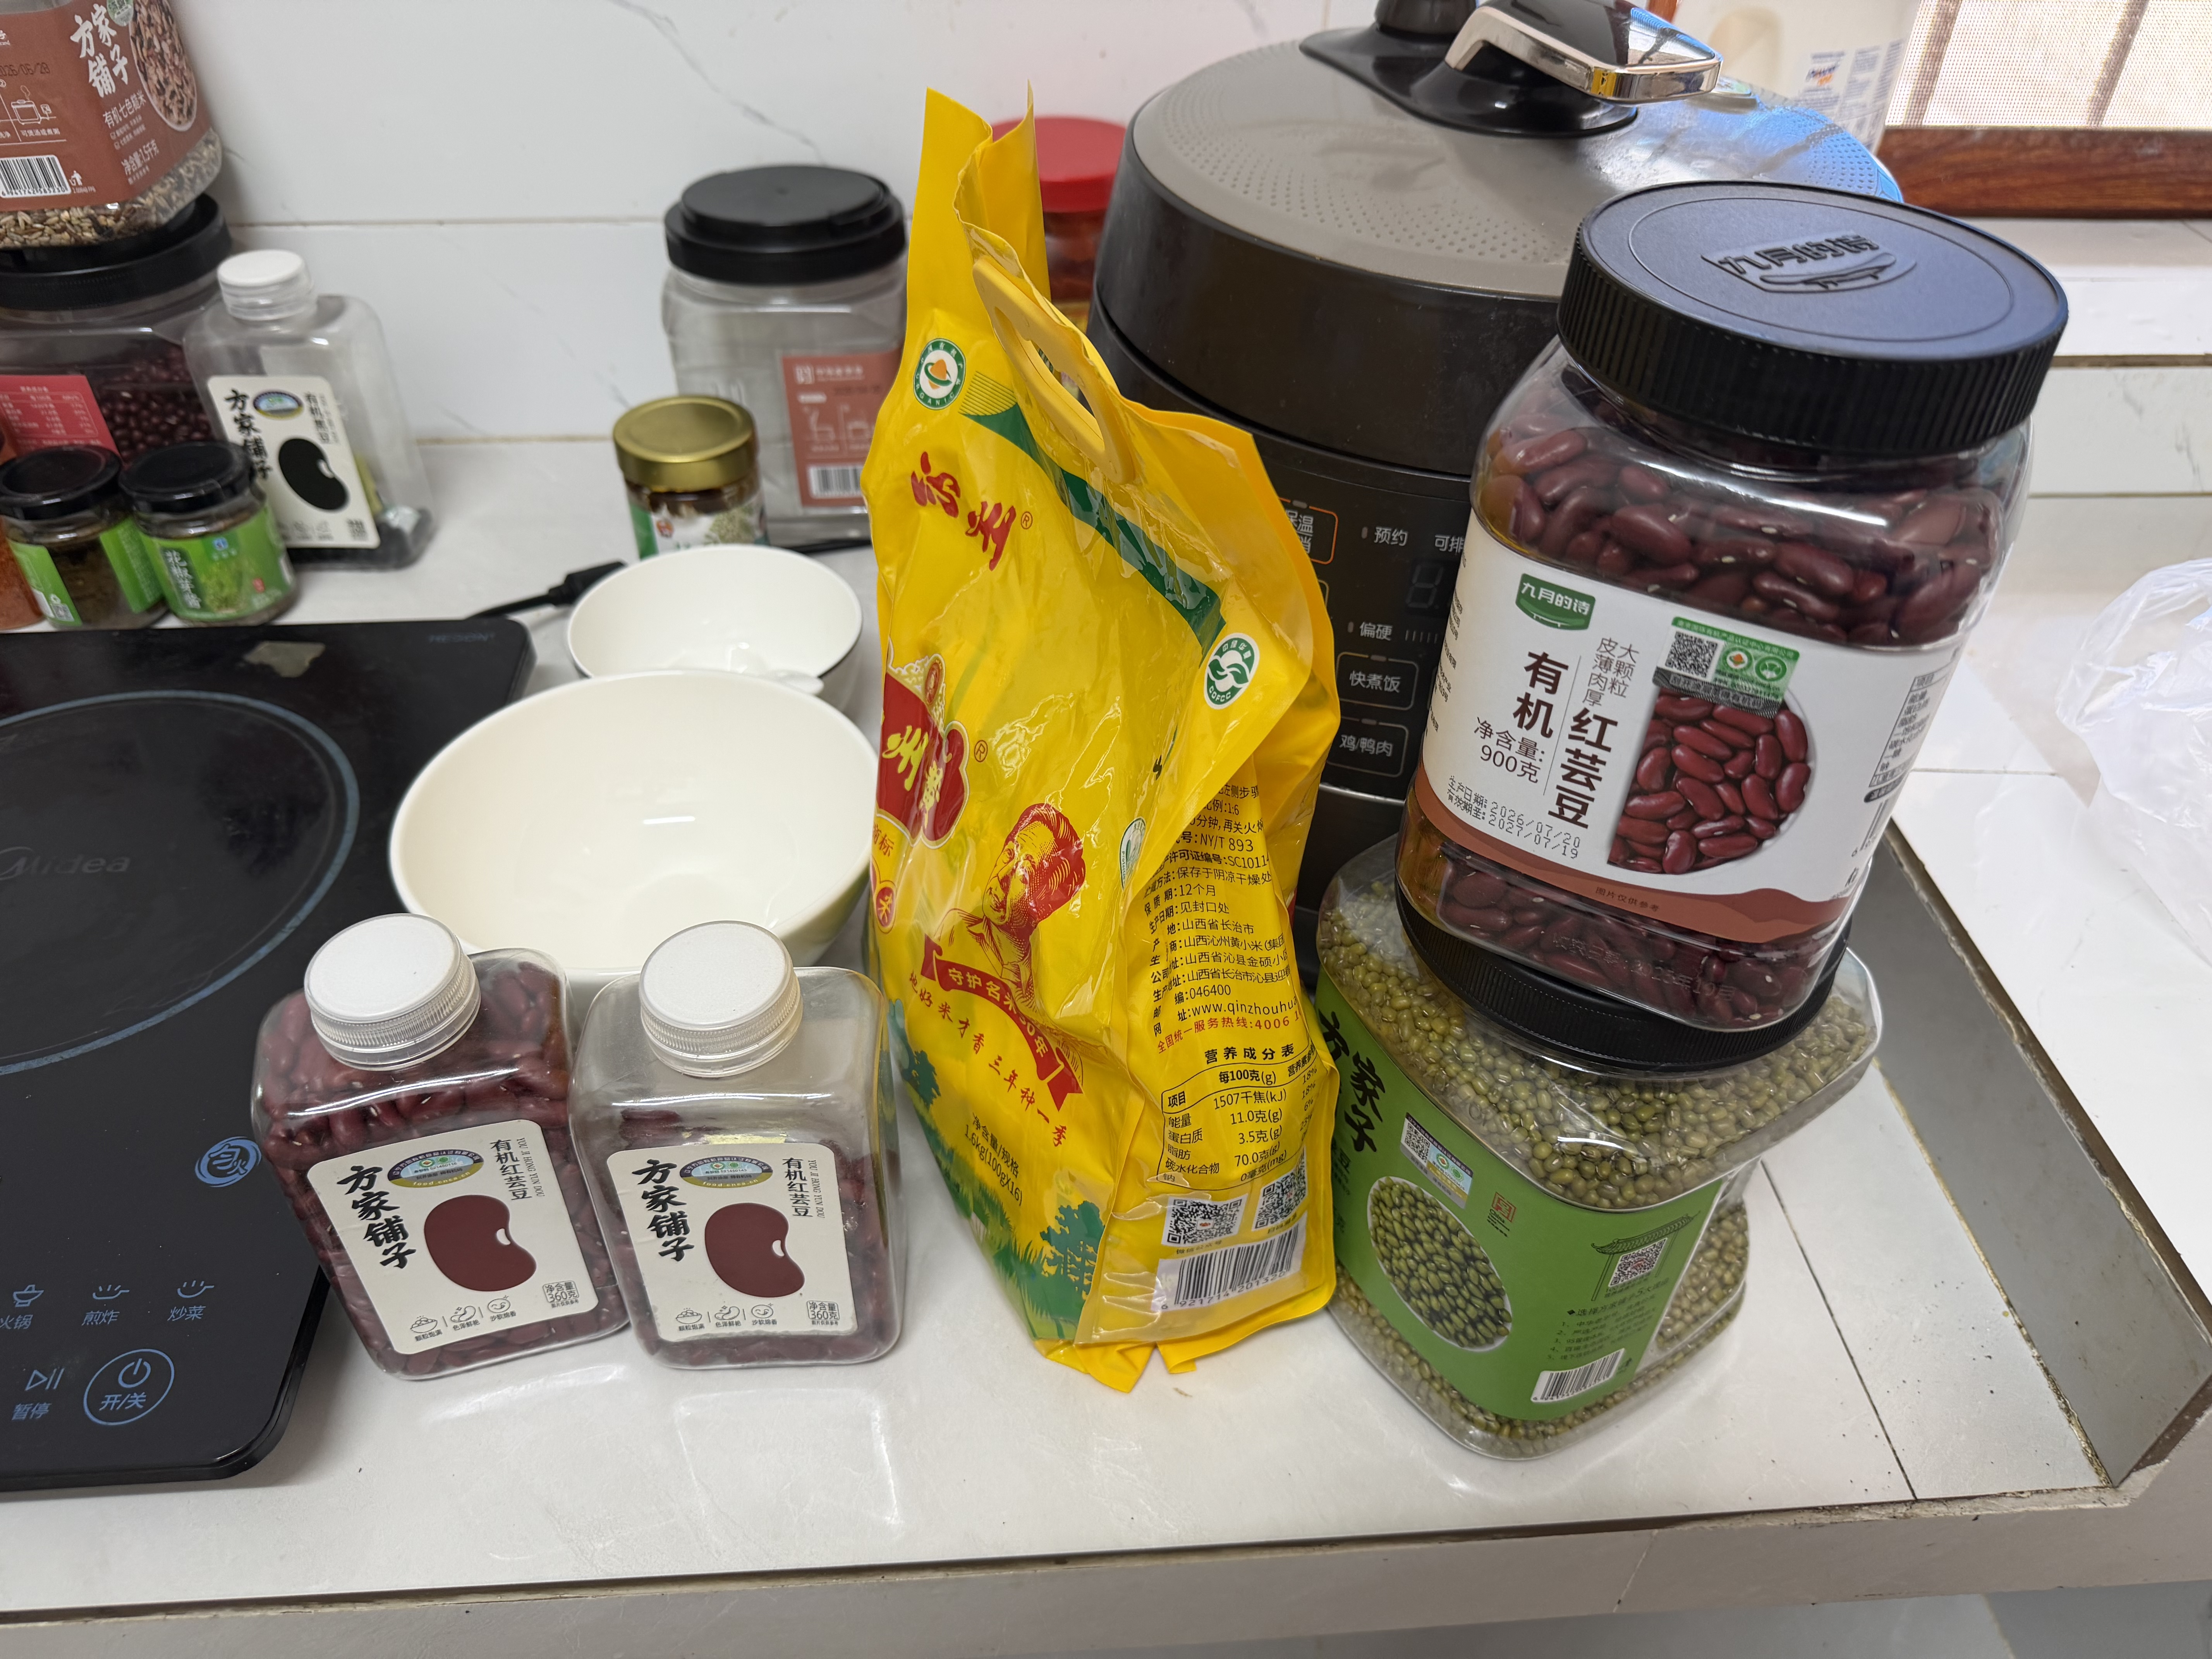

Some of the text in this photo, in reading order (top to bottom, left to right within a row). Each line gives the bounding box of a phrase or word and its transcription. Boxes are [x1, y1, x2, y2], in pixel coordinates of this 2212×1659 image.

[1718, 235, 1880, 273] 九月的诗
[1374, 526, 1408, 547] 预约
[1520, 581, 1590, 617] 九月的诗
[1359, 621, 1393, 641] 偏硬
[1582, 637, 1615, 708] 皮薄肉厚
[1607, 643, 1640, 698] 大颗粒
[1349, 670, 1402, 694] 快煮饭
[1513, 651, 1569, 740] 有机
[1340, 733, 1393, 757] 鸡/鸭肉
[1473, 716, 1546, 764] 净含量:
[1480, 744, 1541, 785] 900克
[1548, 707, 1618, 829] 红芸豆
[1228, 837, 1254, 852] 893
[1204, 1043, 1295, 1065] 营养成分表
[1168, 1091, 1186, 1108] 项目
[1168, 1113, 1192, 1128] 能量
[1168, 1128, 1203, 1144] 蛋白质
[1230, 1108, 1283, 1125] 11.0克(g)
[517, 1137, 528, 1149] YOU
[972, 1112, 1019, 1178] 净含量/规格
[1168, 1144, 1192, 1161] 脂肪
[1238, 1125, 1283, 1144] 3.5克(g)
[489, 1139, 533, 1200] 有机红芸豆
[523, 1156, 536, 1172] HONG
[808, 1160, 818, 1171] YOU
[1165, 1157, 1220, 1175] 碳水化合物
[529, 1173, 541, 1184] YUN
[782, 1157, 813, 1217] 有机红芸豆
[534, 1186, 545, 1197] DOU
[814, 1195, 823, 1206] YUN
[337, 1165, 417, 1269] 方家铺子
[632, 1159, 695, 1262] 方家铺子
[816, 1207, 825, 1218] DOU
[544, 1281, 574, 1293] 净含量
[548, 1290, 578, 1302] 360克
[167, 1305, 206, 1321] 炒菜
[809, 1301, 837, 1311] 净含量
[811, 1310, 839, 1320] 360克
[81, 1309, 120, 1326] 煎炸
[11, 1402, 52, 1421] 暂停
[99, 1392, 147, 1411] 开/关
